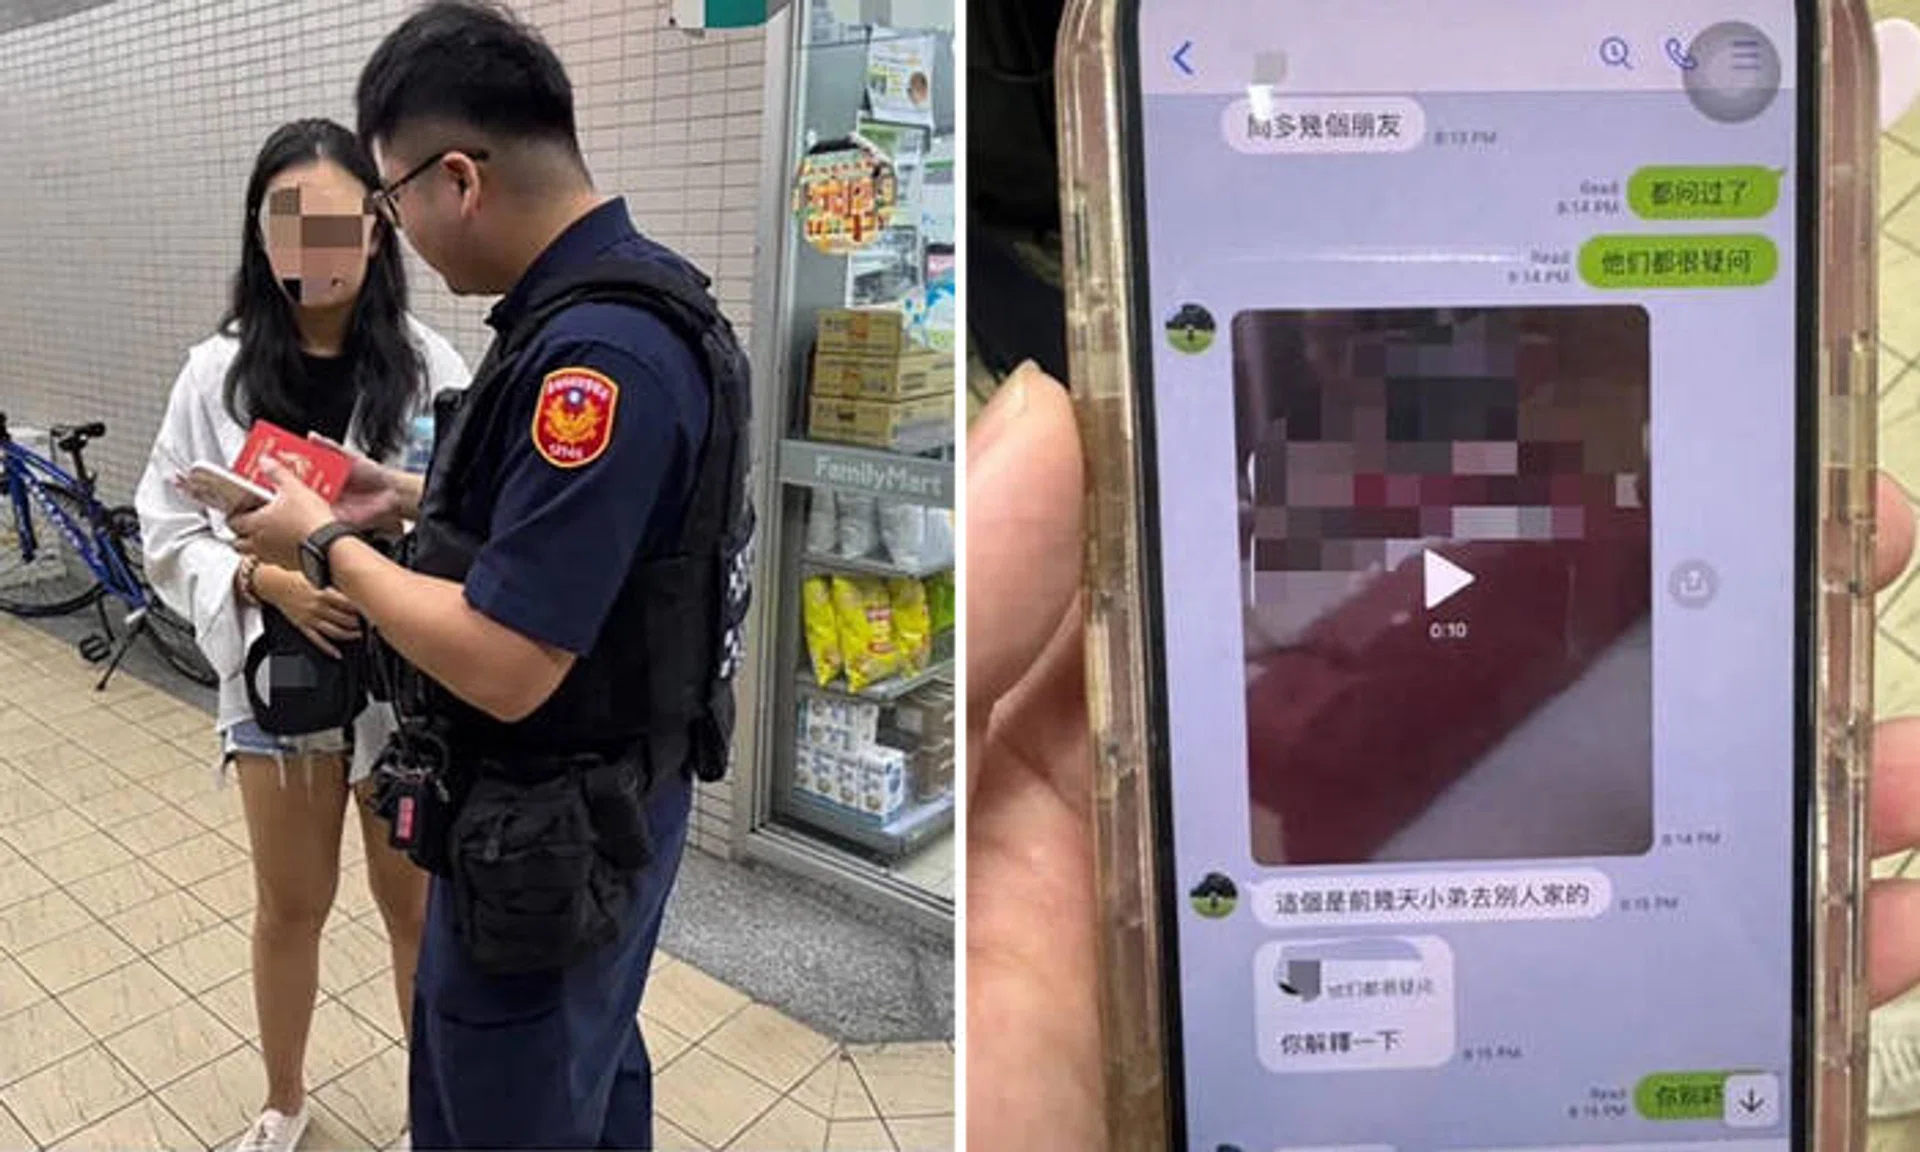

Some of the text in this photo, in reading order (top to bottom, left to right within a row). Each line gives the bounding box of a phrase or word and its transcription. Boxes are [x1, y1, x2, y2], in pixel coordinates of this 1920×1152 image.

[1651, 179, 1750, 206] 都问过了
[1601, 248, 1752, 276] 他们都很疑问
[814, 454, 943, 497] FamilyMart
[1429, 621, 1467, 638] 0:10
[1281, 1029, 1402, 1055] 你解釋一下
